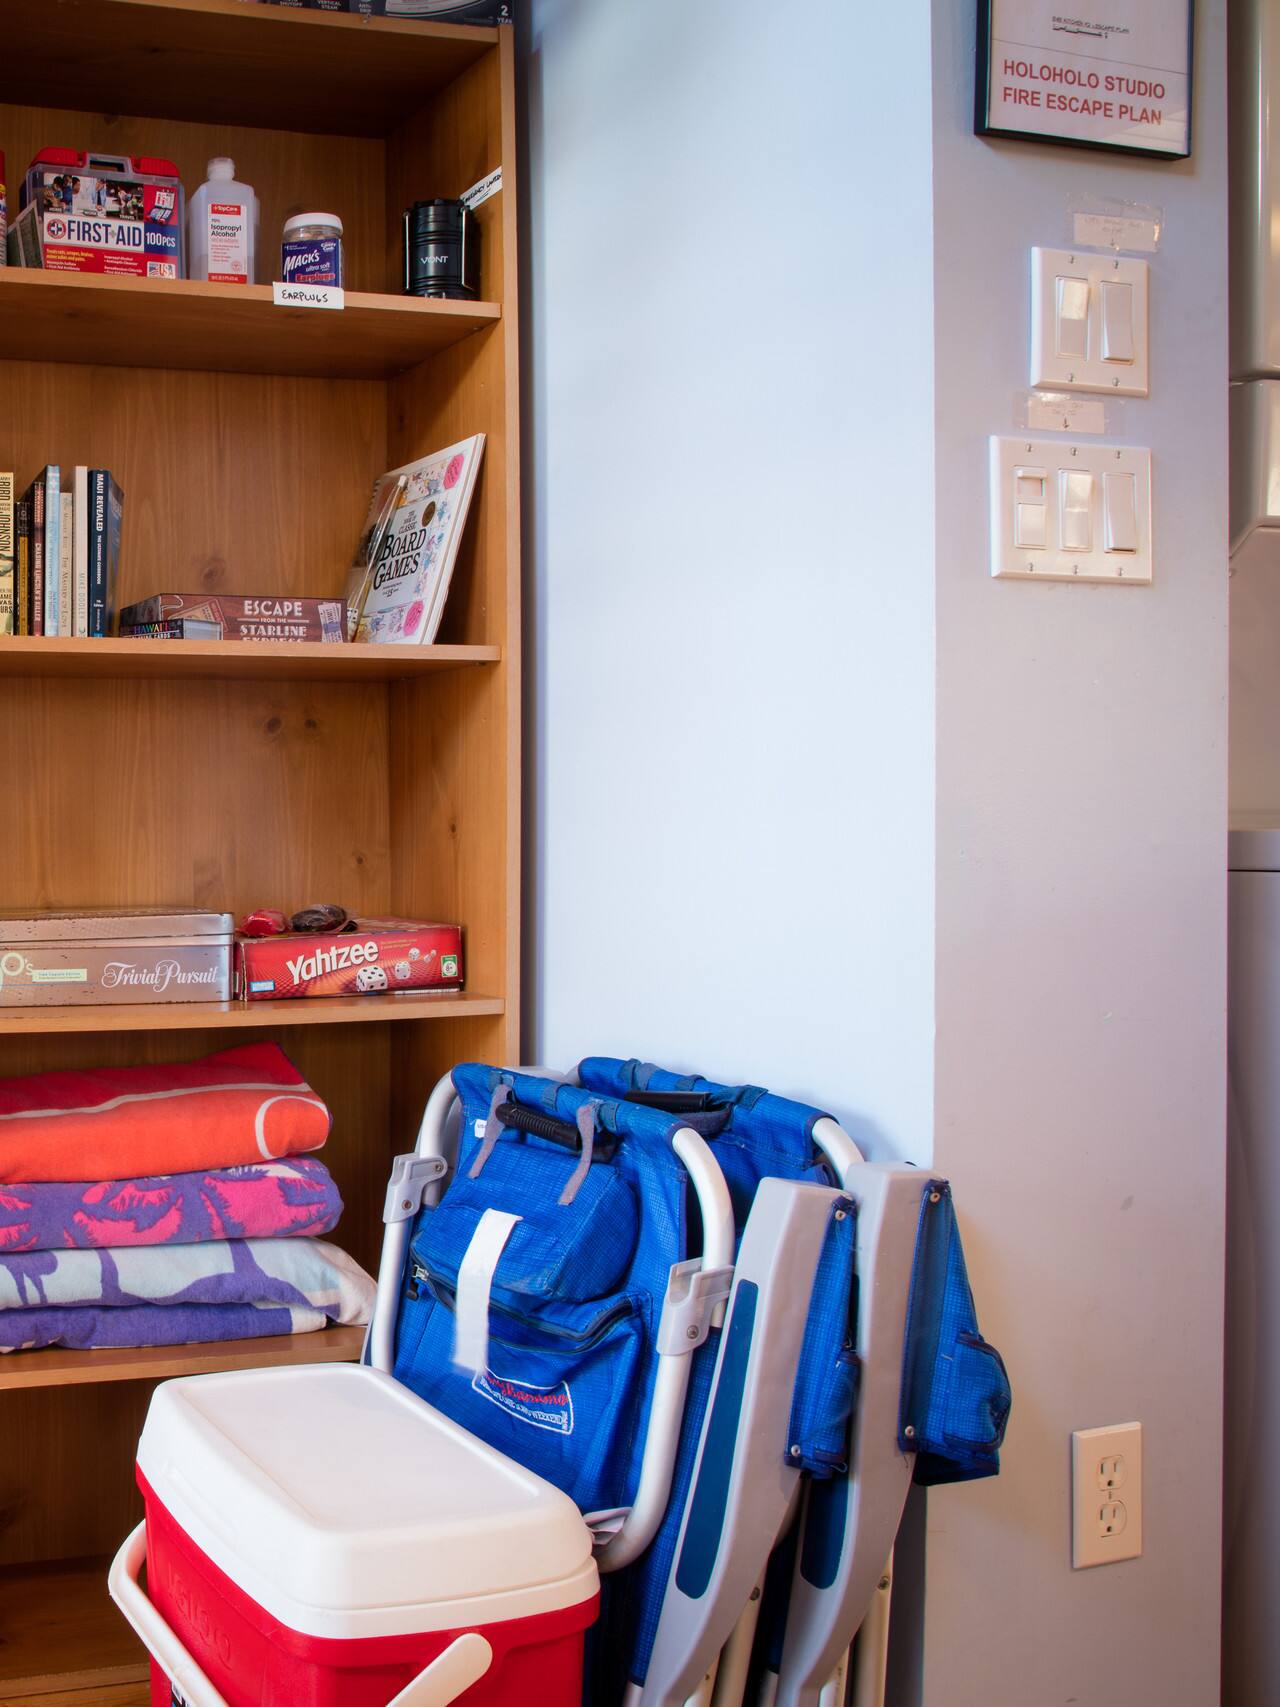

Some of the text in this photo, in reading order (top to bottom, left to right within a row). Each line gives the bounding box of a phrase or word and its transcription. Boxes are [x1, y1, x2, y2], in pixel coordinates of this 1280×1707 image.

[501, 5, 509, 16] 2
[1004, 59, 1165, 99] HOLOHOLO STUDIO
[1003, 87, 1162, 125] FIRE ESCAPE PLAN
[67, 219, 142, 247] FIRST AID
[145, 231, 176, 248] 100 PCS
[210, 224, 242, 232] Isopropyl
[420, 255, 448, 264] VONT
[281, 289, 329, 303] EARPLUGS
[96, 473, 104, 532] MAUI REVEALED
[379, 528, 427, 562] BOARD
[373, 552, 421, 590] GAMES
[243, 600, 303, 617] ESCAPE
[240, 624, 307, 637] STARLINE
[101, 959, 219, 993] Trivial Pursuit
[286, 941, 379, 985] Yahtzee
